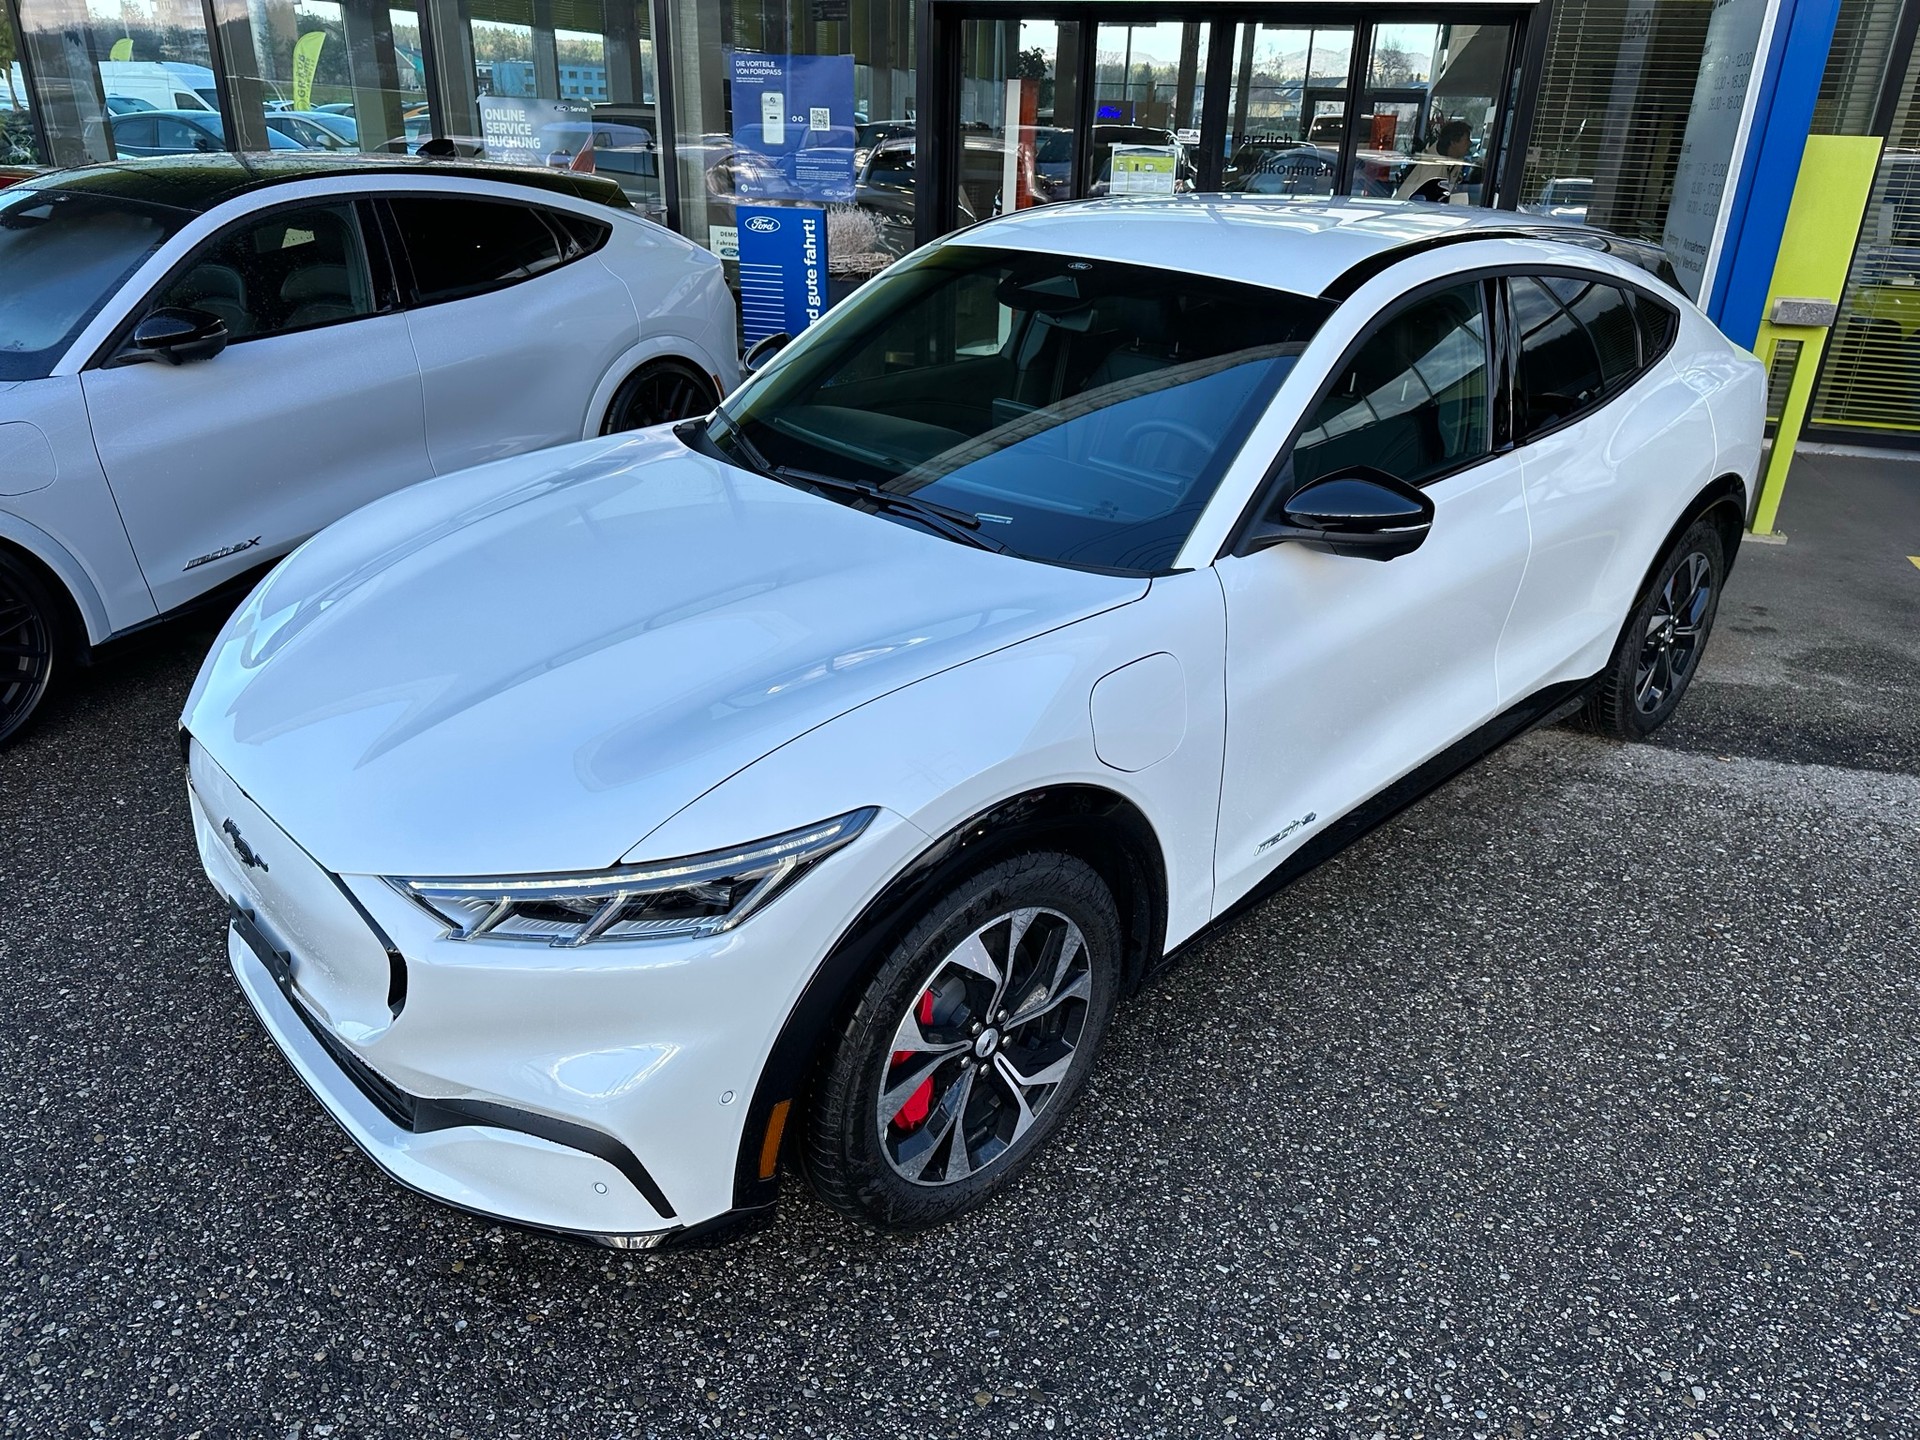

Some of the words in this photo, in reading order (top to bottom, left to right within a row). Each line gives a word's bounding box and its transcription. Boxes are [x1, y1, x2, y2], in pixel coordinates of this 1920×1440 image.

[746, 60, 775, 68] VORTEILE
[484, 108, 526, 122] ONLINE
[486, 122, 532, 136] SERVICE
[487, 135, 541, 149] BUCHUNG
[1232, 132, 1293, 145] Herzlich
[802, 219, 817, 266] fahrt!
[805, 270, 821, 306] gute
